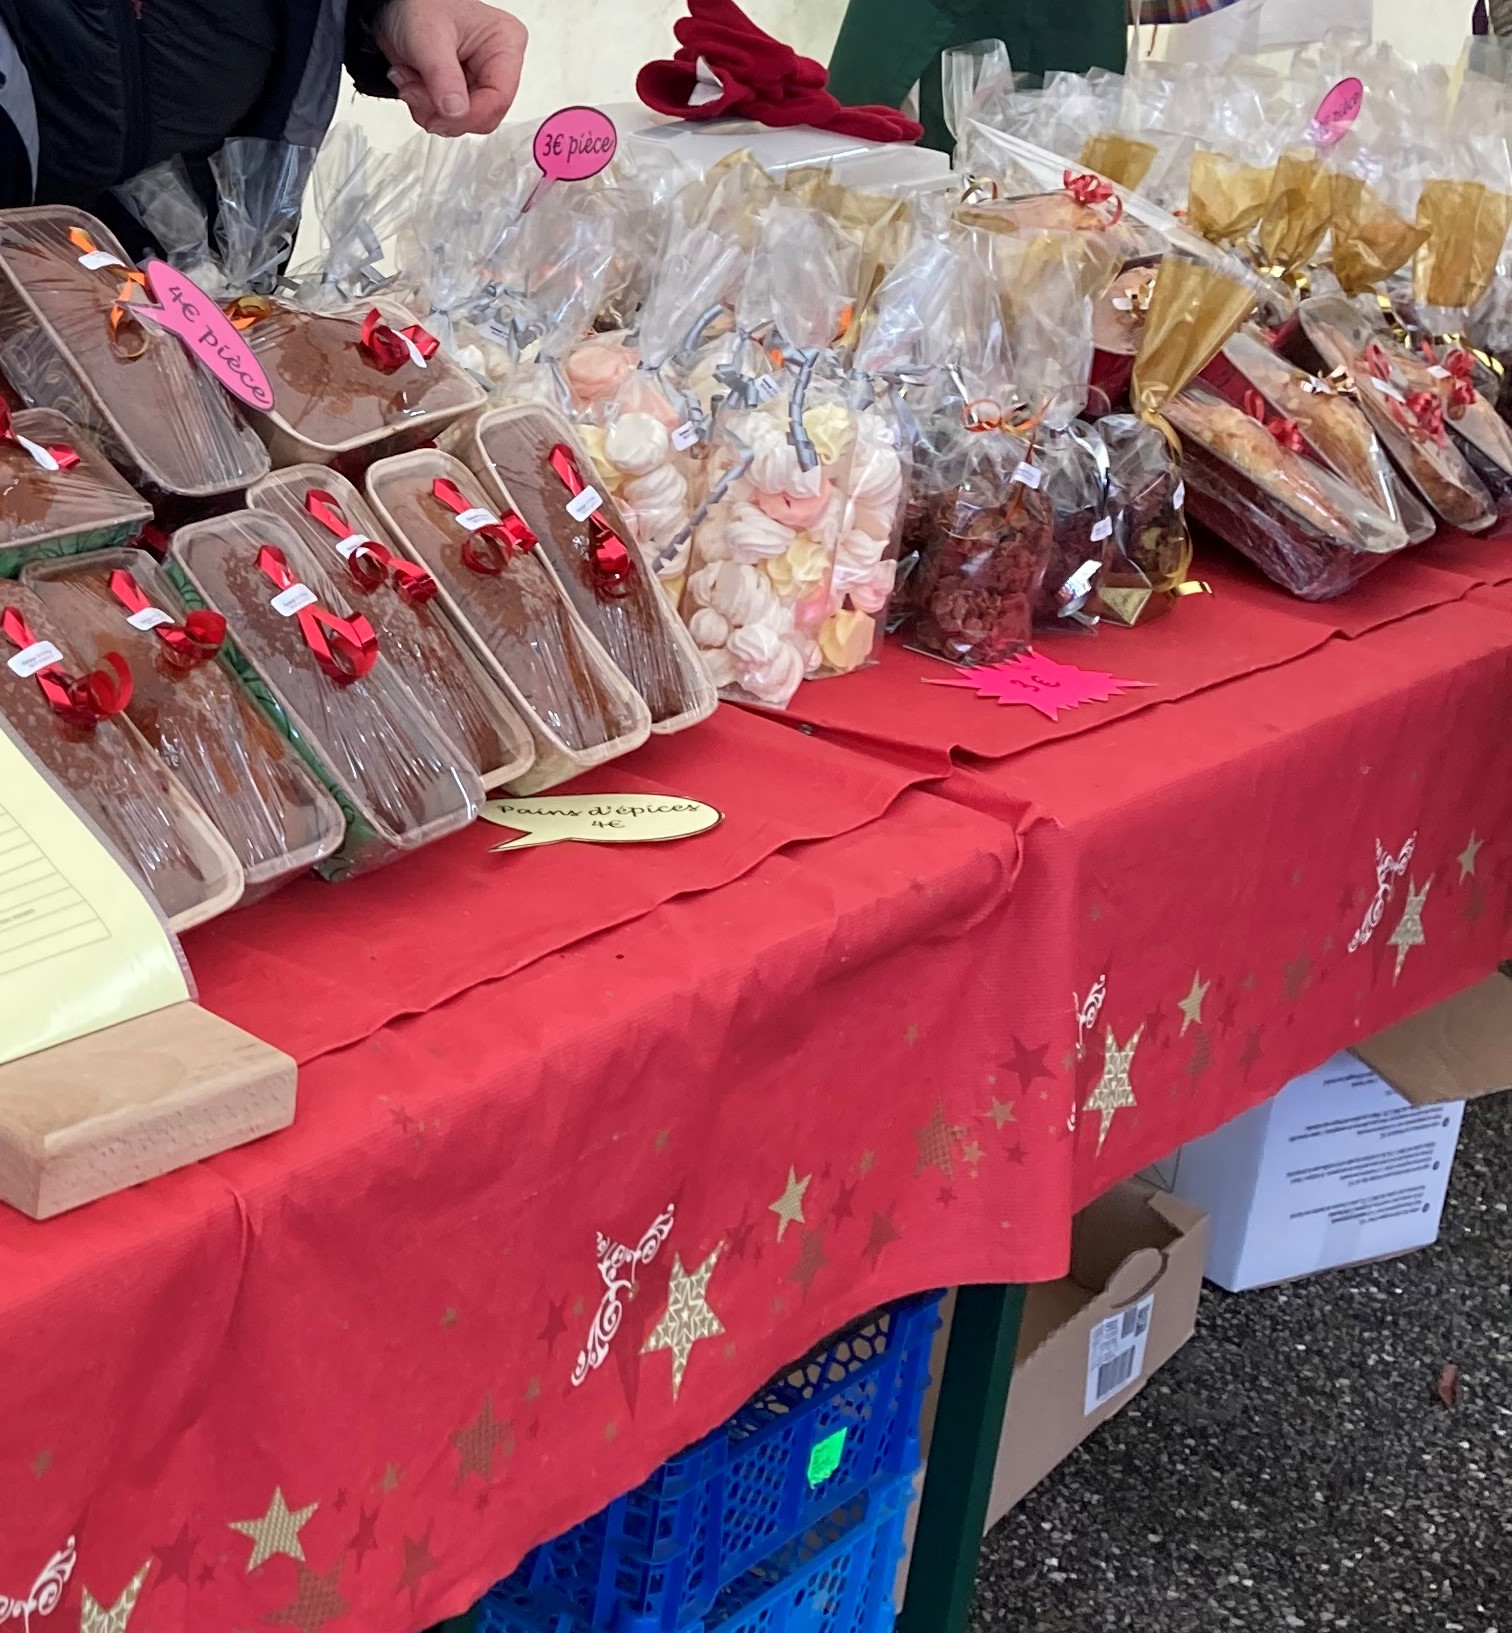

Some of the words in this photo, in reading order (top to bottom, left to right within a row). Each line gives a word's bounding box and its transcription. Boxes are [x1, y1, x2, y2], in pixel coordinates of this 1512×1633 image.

[542, 132, 562, 156] 3€
[567, 130, 613, 163] pièce
[169, 286, 200, 323] 4€
[199, 325, 270, 404] pièce
[498, 804, 581, 817] Pains
[588, 802, 700, 818] d'épices
[591, 820, 626, 829] 4€
